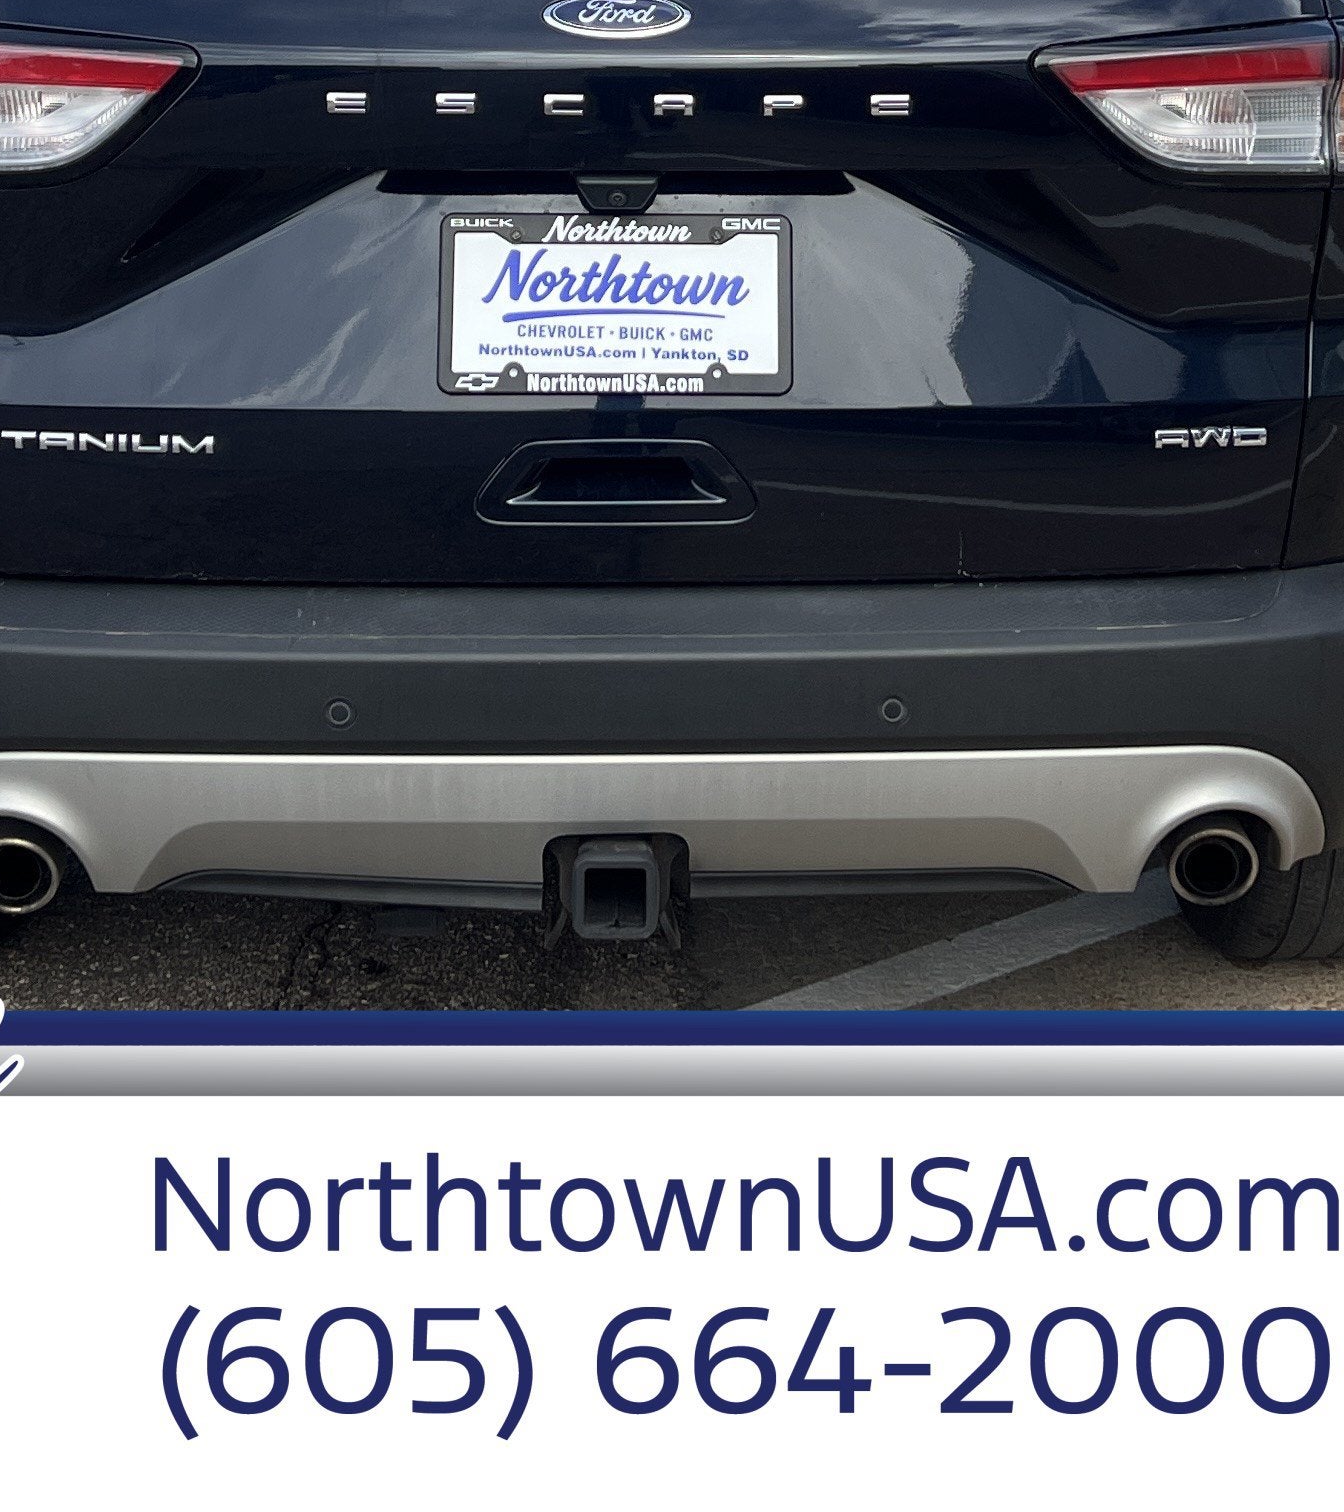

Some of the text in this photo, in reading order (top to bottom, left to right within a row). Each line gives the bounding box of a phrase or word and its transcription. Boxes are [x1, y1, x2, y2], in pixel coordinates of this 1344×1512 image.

[325, 91, 911, 117] ESCAPE
[450, 214, 782, 244] BUICK Northtown GMC
[481, 248, 751, 308] Northtown
[516, 324, 714, 342] CHEVROLET BUICK GMC
[478, 343, 637, 360] NorthtownUSA.com
[651, 347, 722, 365] Yankton,
[726, 349, 749, 362] SD
[526, 373, 704, 393] NorthtownUSA.com
[1154, 425, 1268, 449] AWD
